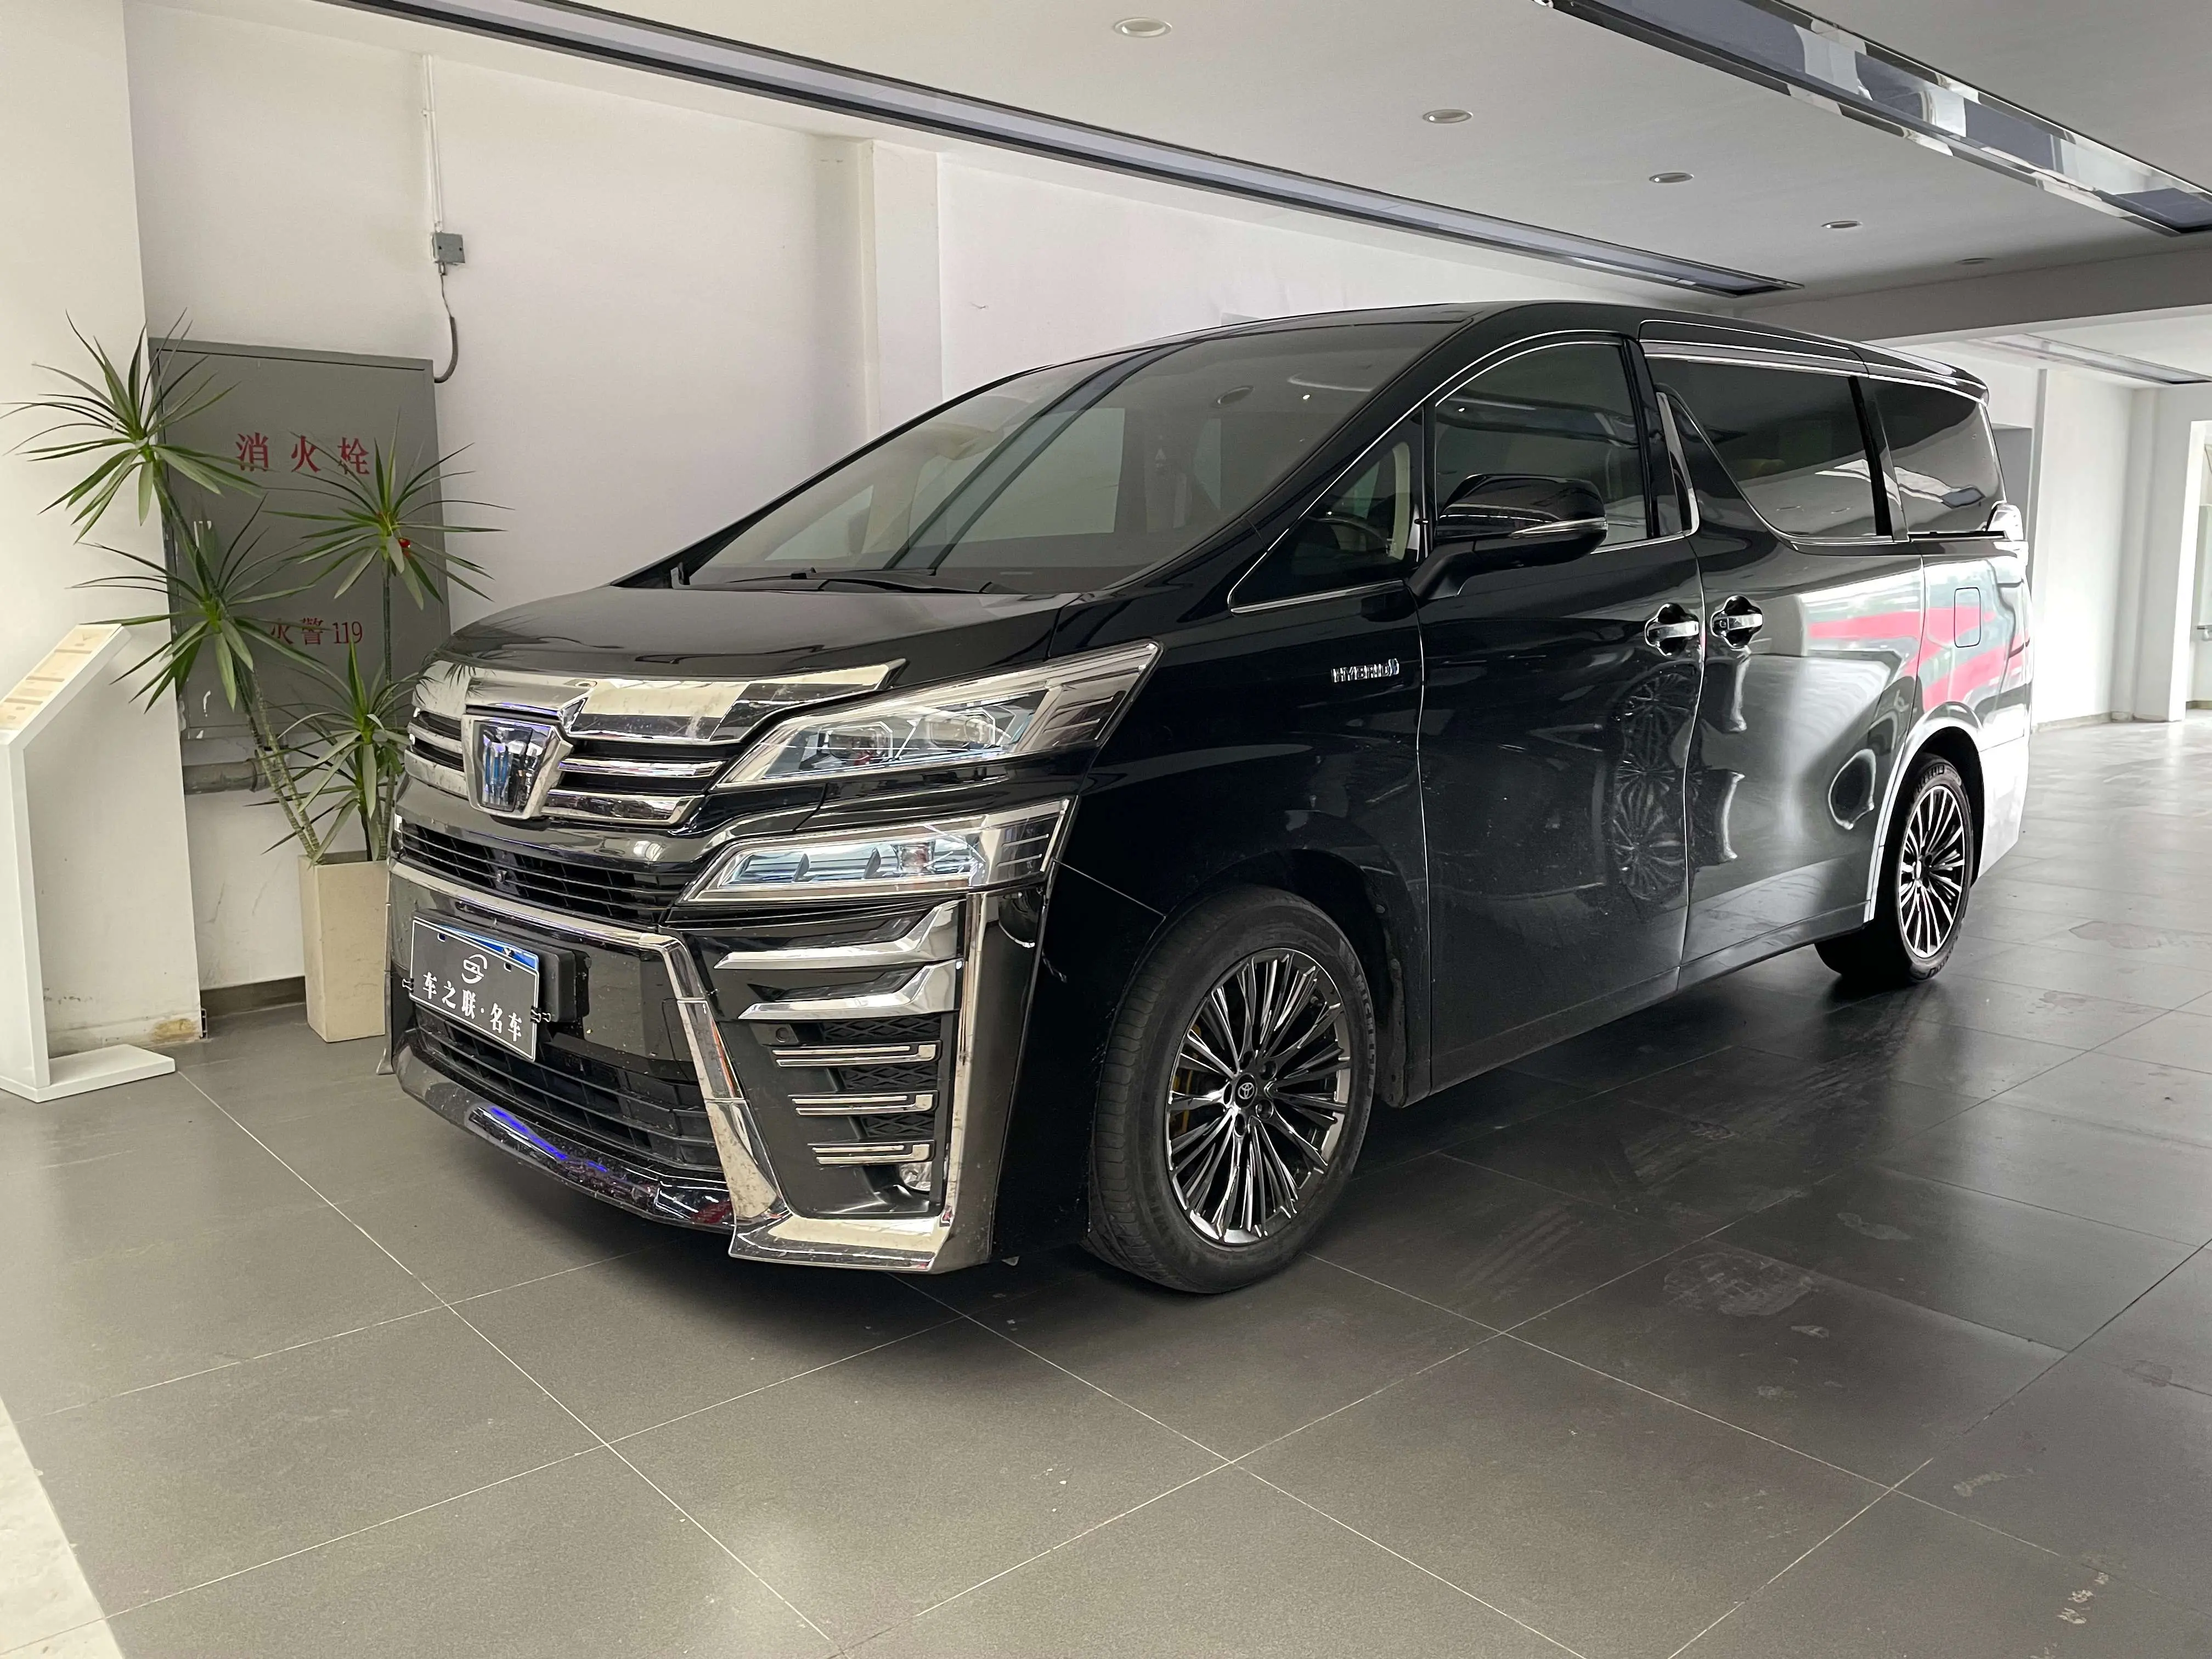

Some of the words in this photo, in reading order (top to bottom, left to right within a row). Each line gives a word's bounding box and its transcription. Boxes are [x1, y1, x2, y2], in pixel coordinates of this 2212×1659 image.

[235, 432, 370, 475] 消火栓
[1331, 663, 1391, 683] HYBRID
